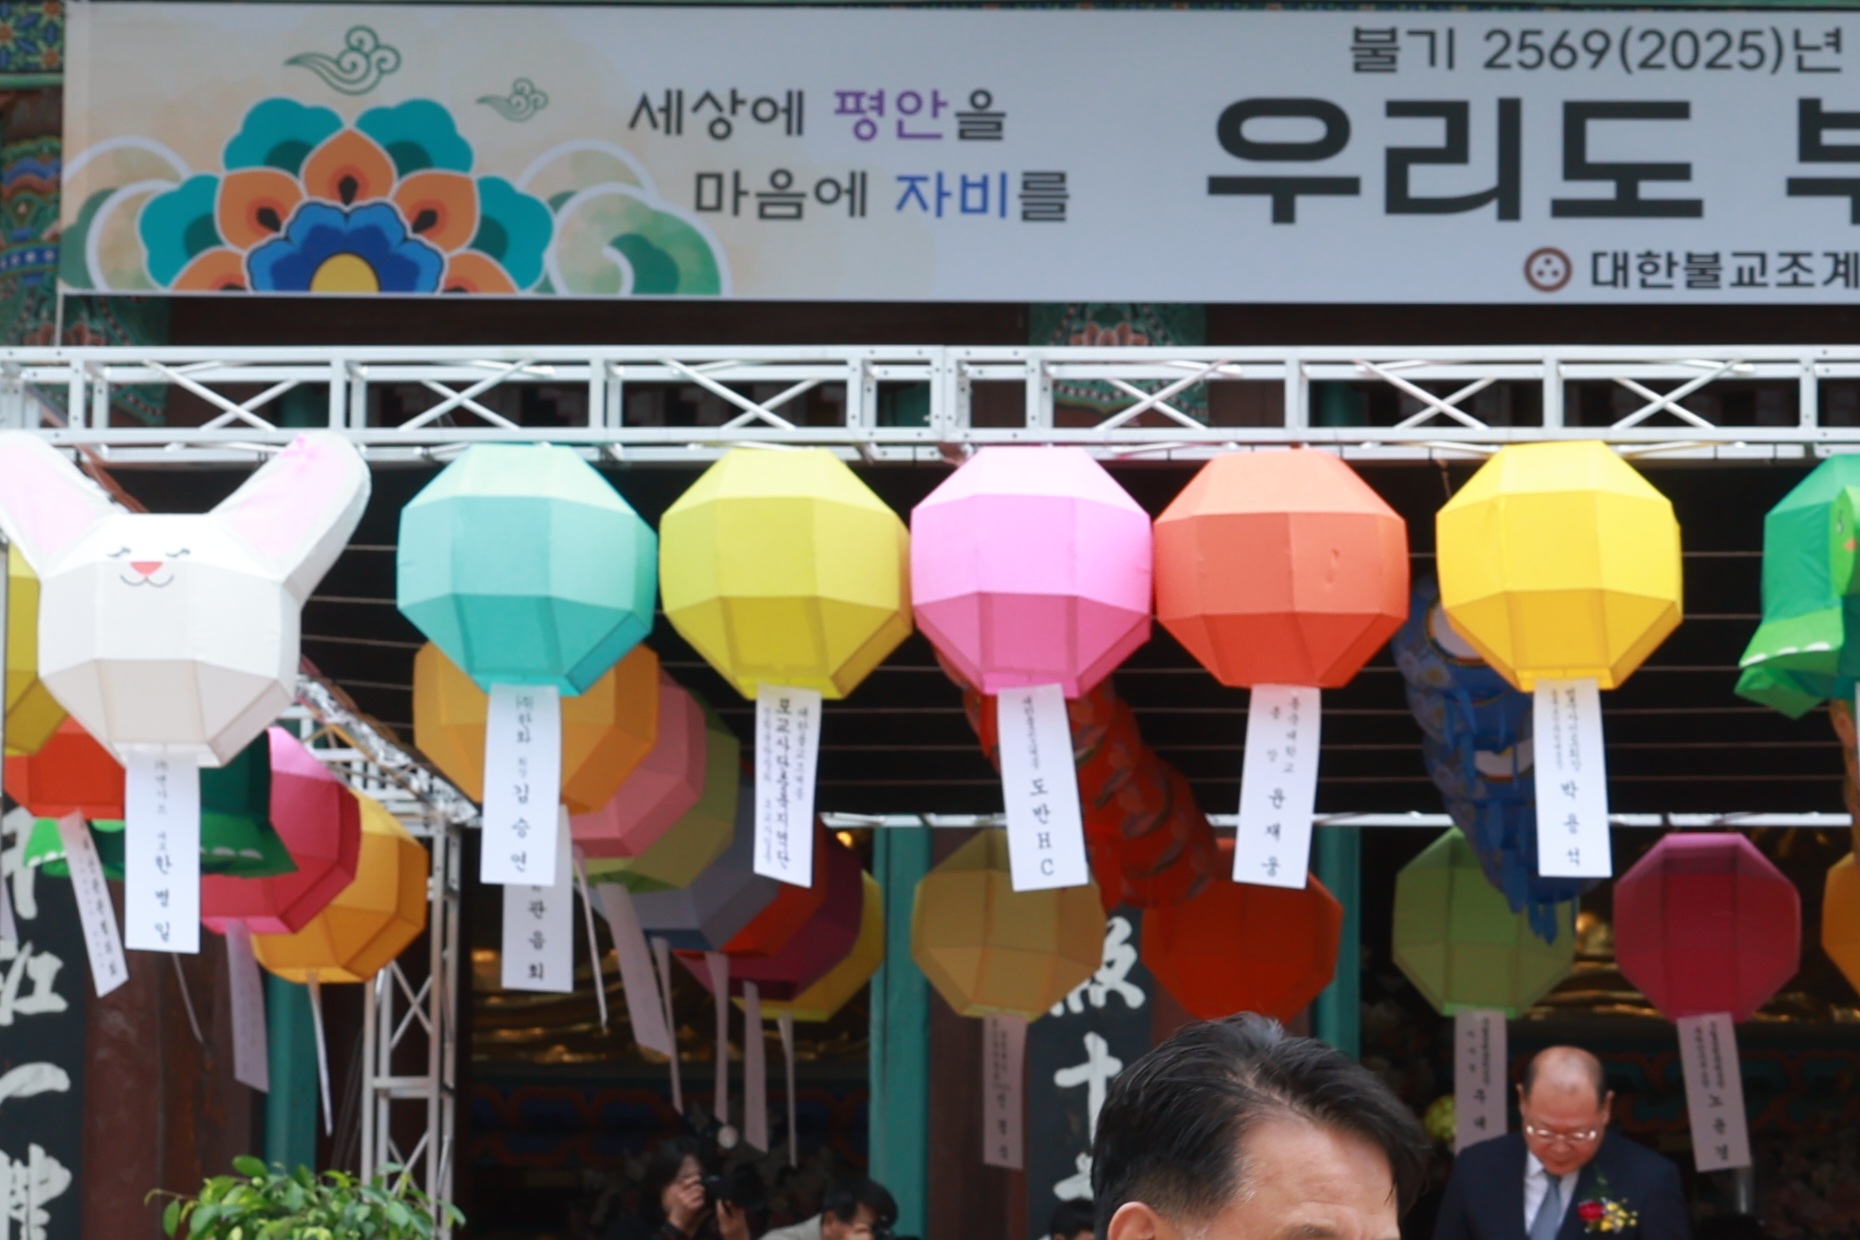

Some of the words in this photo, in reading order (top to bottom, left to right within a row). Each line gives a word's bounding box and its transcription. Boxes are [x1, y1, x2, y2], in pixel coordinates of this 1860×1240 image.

[1350, 26, 1455, 73] 불기
[1483, 26, 1842, 75] 2569(2025)년
[628, 88, 804, 141] 세상에
[835, 89, 1007, 141] 평안을
[1207, 97, 1704, 225] 우리도
[693, 170, 868, 222] 마음에
[896, 171, 1070, 222] 자비를
